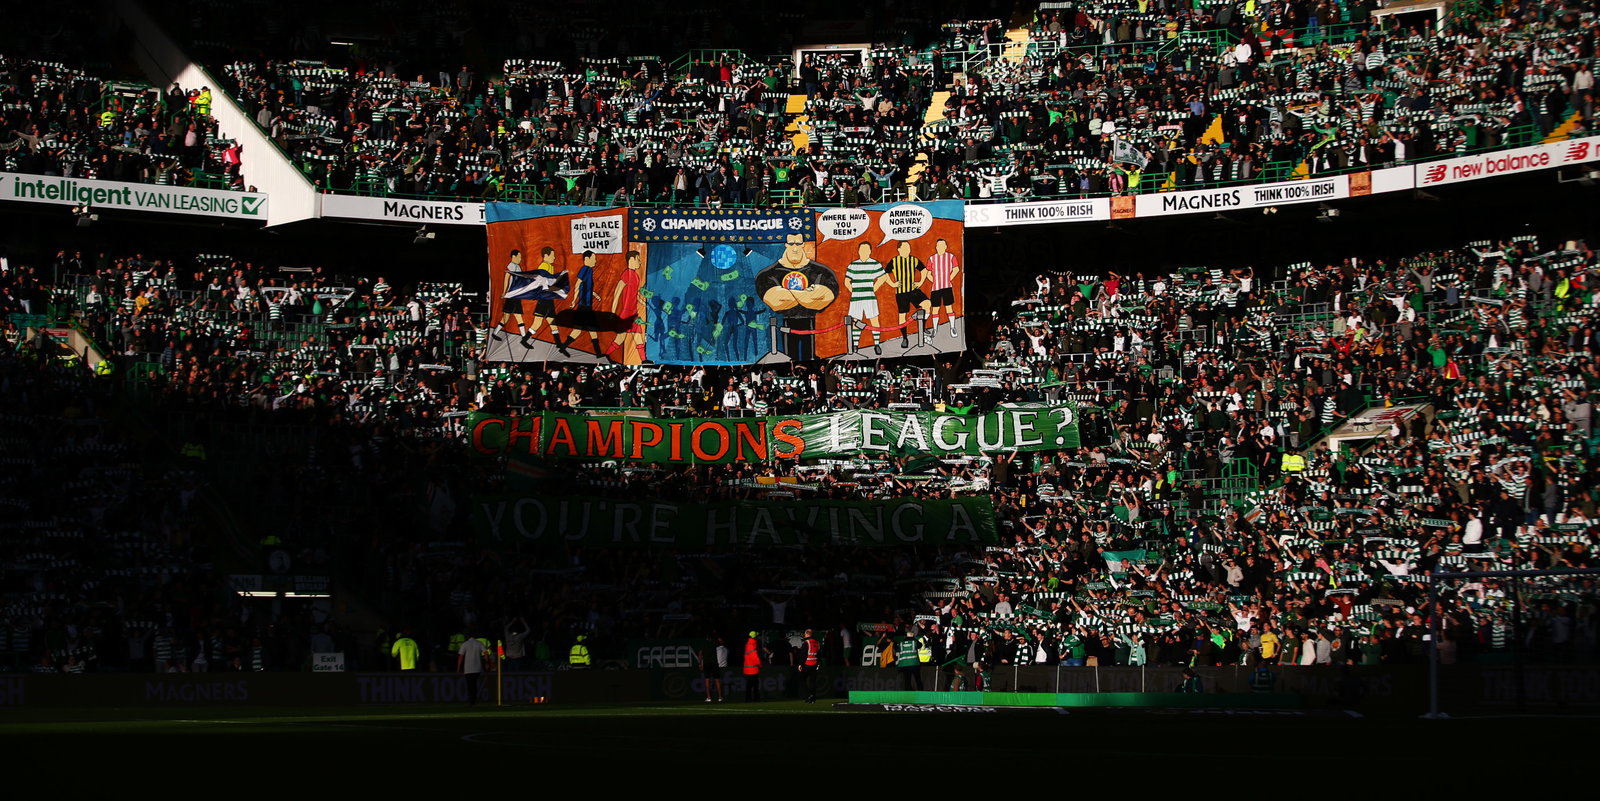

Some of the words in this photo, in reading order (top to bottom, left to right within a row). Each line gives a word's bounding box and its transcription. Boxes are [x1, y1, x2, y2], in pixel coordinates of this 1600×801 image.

[1453, 161, 1484, 179] new
[1486, 152, 1549, 174] balance
[14, 176, 131, 206] intelligent
[135, 191, 169, 208] VAN
[173, 194, 238, 213] LEASING
[1162, 190, 1241, 211] MAGNERS
[1254, 188, 1282, 202] THINK
[1285, 186, 1309, 199] 100%
[1311, 183, 1335, 196] IRISH
[384, 201, 463, 220] MAGNERS
[822, 214, 846, 222] WHERE
[849, 213, 867, 221] HAVE
[1005, 207, 1035, 219] THINK
[1038, 206, 1064, 218] 100%
[1066, 204, 1093, 216] IRISH
[589, 220, 620, 230] PLACE
[661, 218, 735, 231] CHAMPIONS
[735, 218, 784, 231] LEAGUE
[833, 228, 857, 236] BEEN?
[892, 226, 921, 234] GREECE
[583, 240, 610, 250] JUMP
[471, 415, 806, 461] CHAMPIONS
[829, 406, 1074, 453] LEAGUE?
[481, 498, 679, 544] YOU'RE
[946, 502, 982, 542] A
[320, 655, 336, 663] Exit
[637, 645, 704, 669] GREEN
[313, 663, 332, 671] Gate
[334, 663, 344, 671] 14
[145, 680, 248, 701] MAGNERS
[357, 676, 426, 702] THINK
[498, 676, 553, 702] RISH
